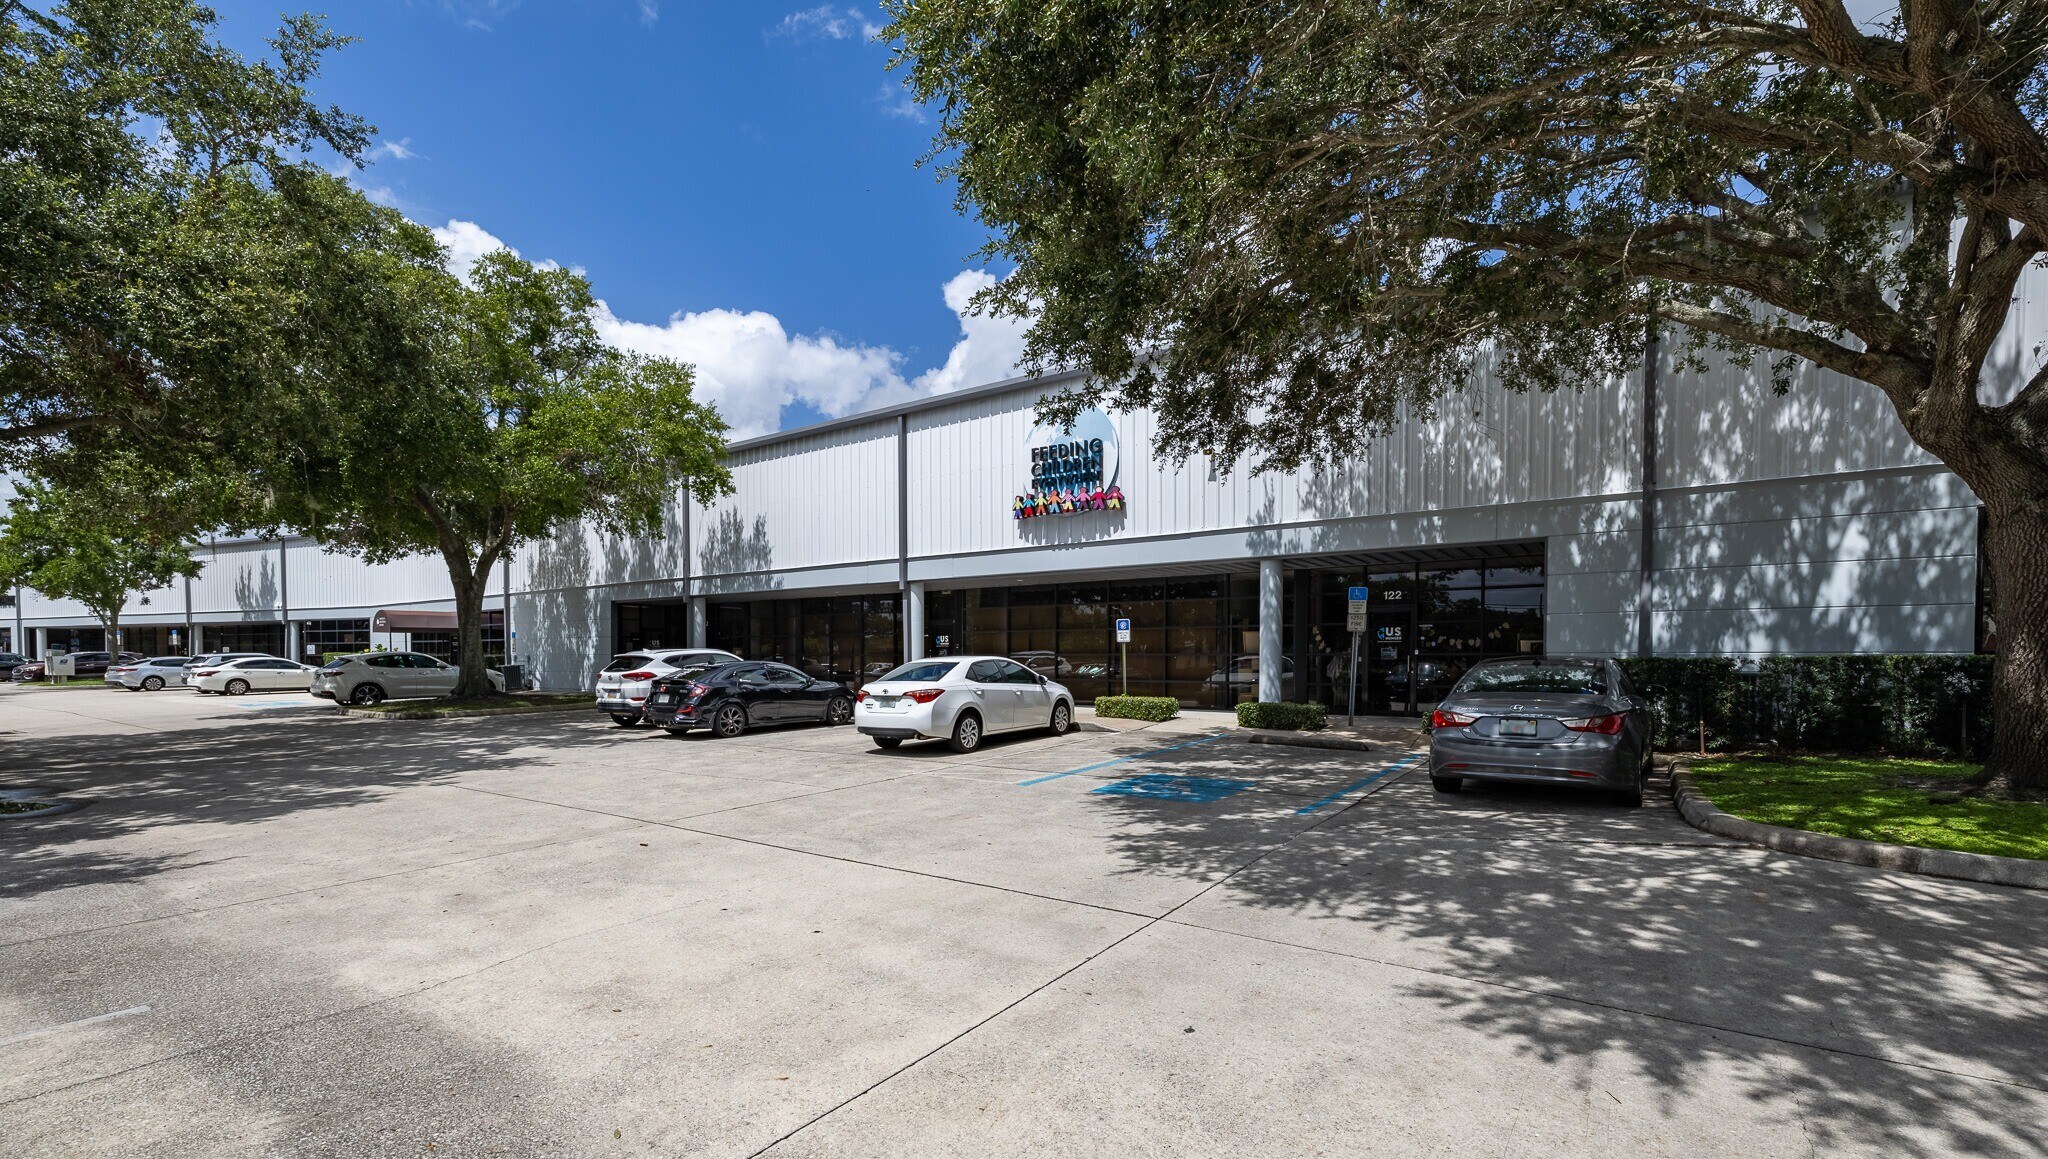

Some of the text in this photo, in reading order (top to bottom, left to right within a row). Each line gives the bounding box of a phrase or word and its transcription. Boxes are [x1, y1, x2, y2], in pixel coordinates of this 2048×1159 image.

[1031, 438, 1103, 462] FEEDING
[1031, 455, 1103, 477] CHILDREN
[1383, 591, 1402, 600] 122
